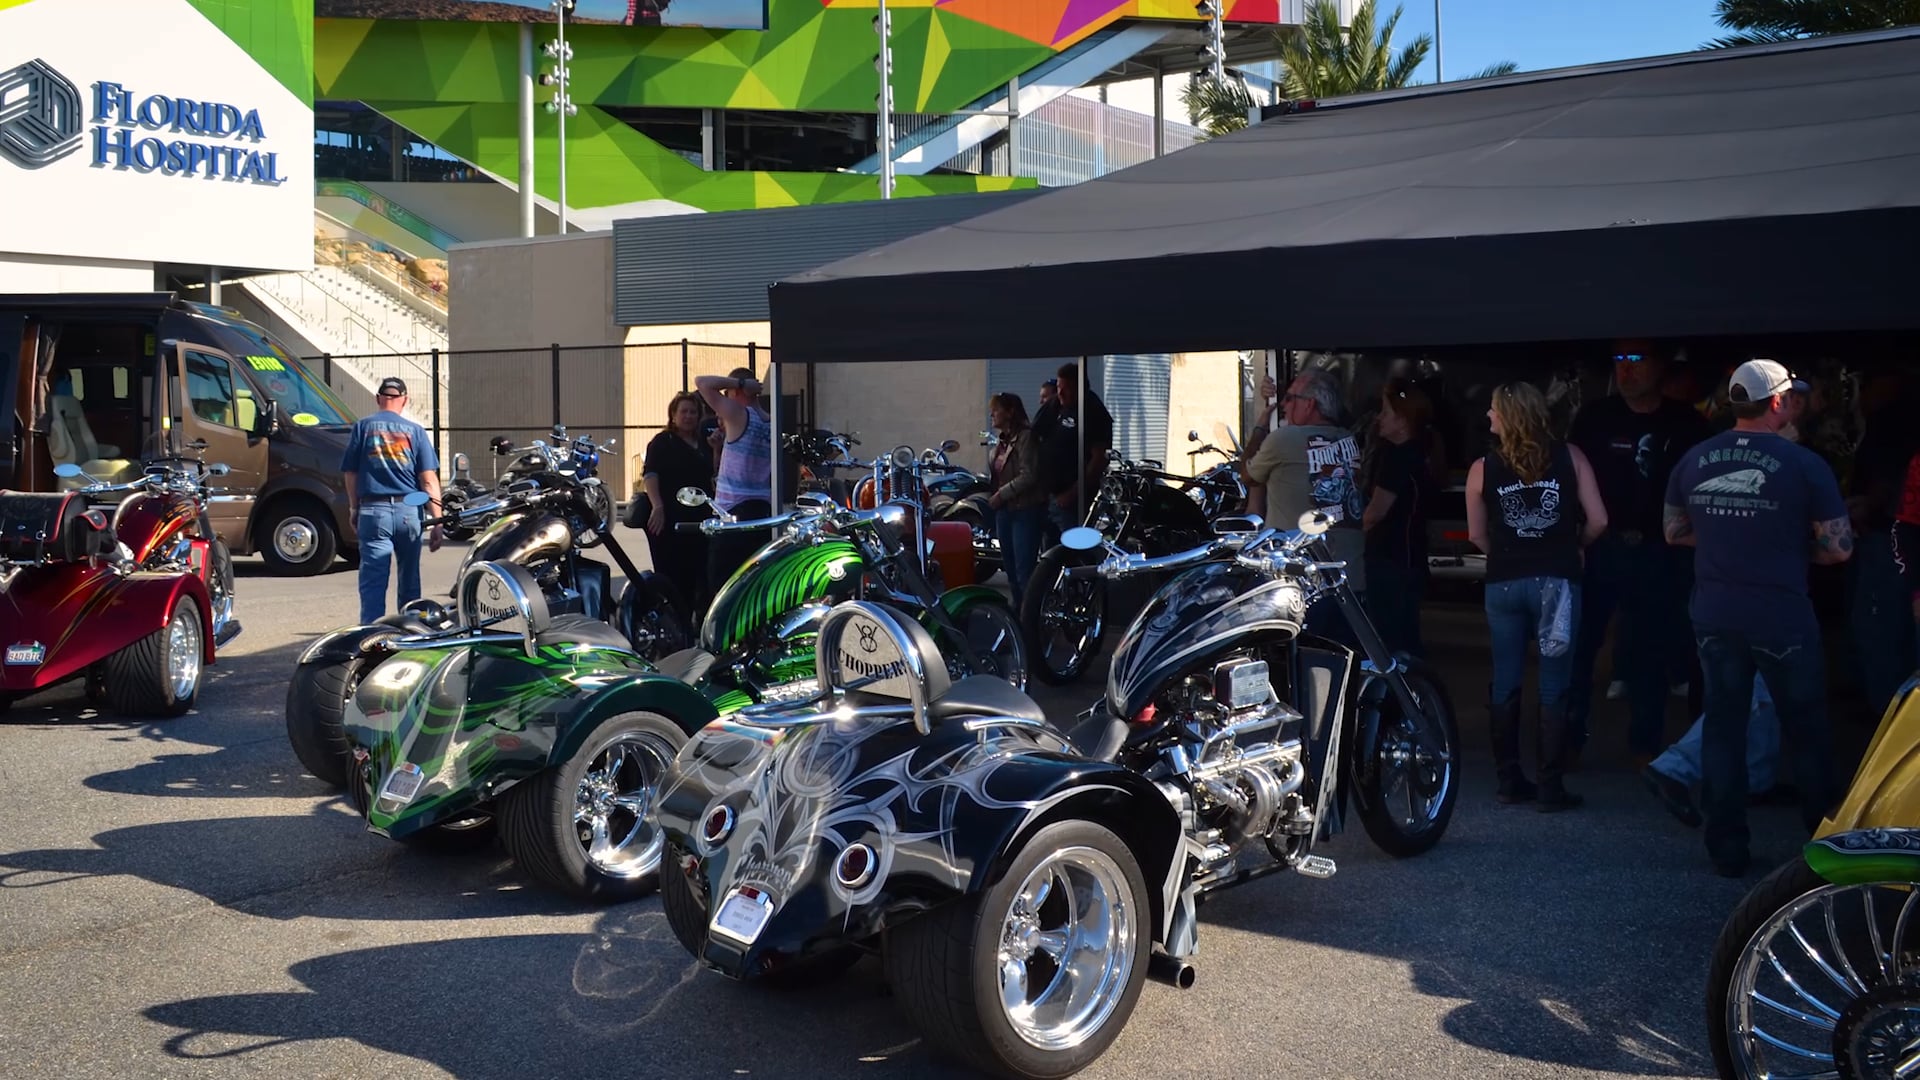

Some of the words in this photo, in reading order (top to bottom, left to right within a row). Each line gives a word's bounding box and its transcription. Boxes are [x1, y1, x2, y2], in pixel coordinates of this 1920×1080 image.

[90, 80, 267, 143] FLORIDA
[89, 126, 288, 187] HOSPITAL
[1698, 448, 1782, 473] AMERICA'S
[1706, 507, 1756, 517] COMPANY
